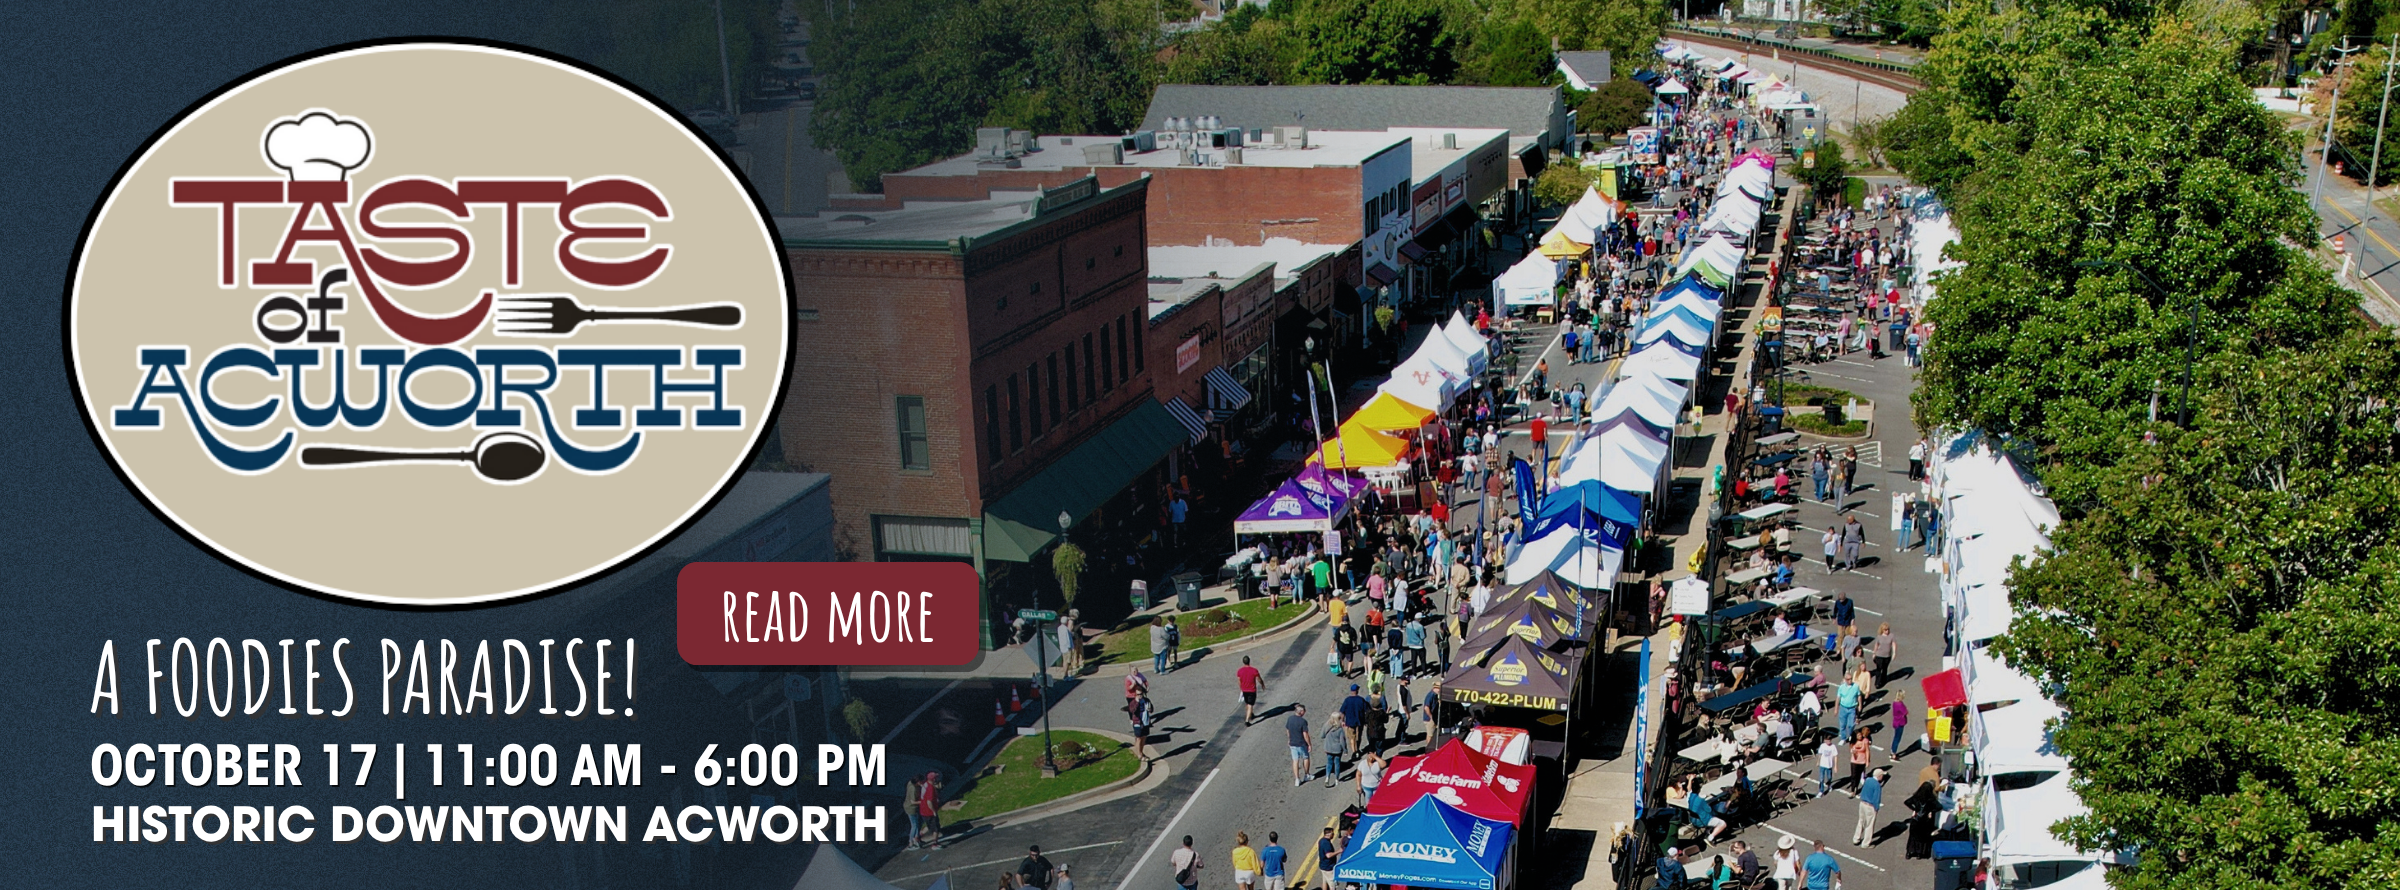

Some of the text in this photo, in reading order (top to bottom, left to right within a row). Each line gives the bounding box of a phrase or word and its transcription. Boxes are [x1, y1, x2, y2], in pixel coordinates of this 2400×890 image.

[1021, 611, 1046, 619] DALLAS
[1494, 665, 1525, 674] Superior
[1454, 688, 1557, 710] 770-422-PLUM
[1466, 819, 1487, 855] MONEY
[1379, 841, 1459, 860] MONEY
[1338, 868, 1377, 877] MONEY
[1378, 872, 1437, 884] MoneyPages.com
